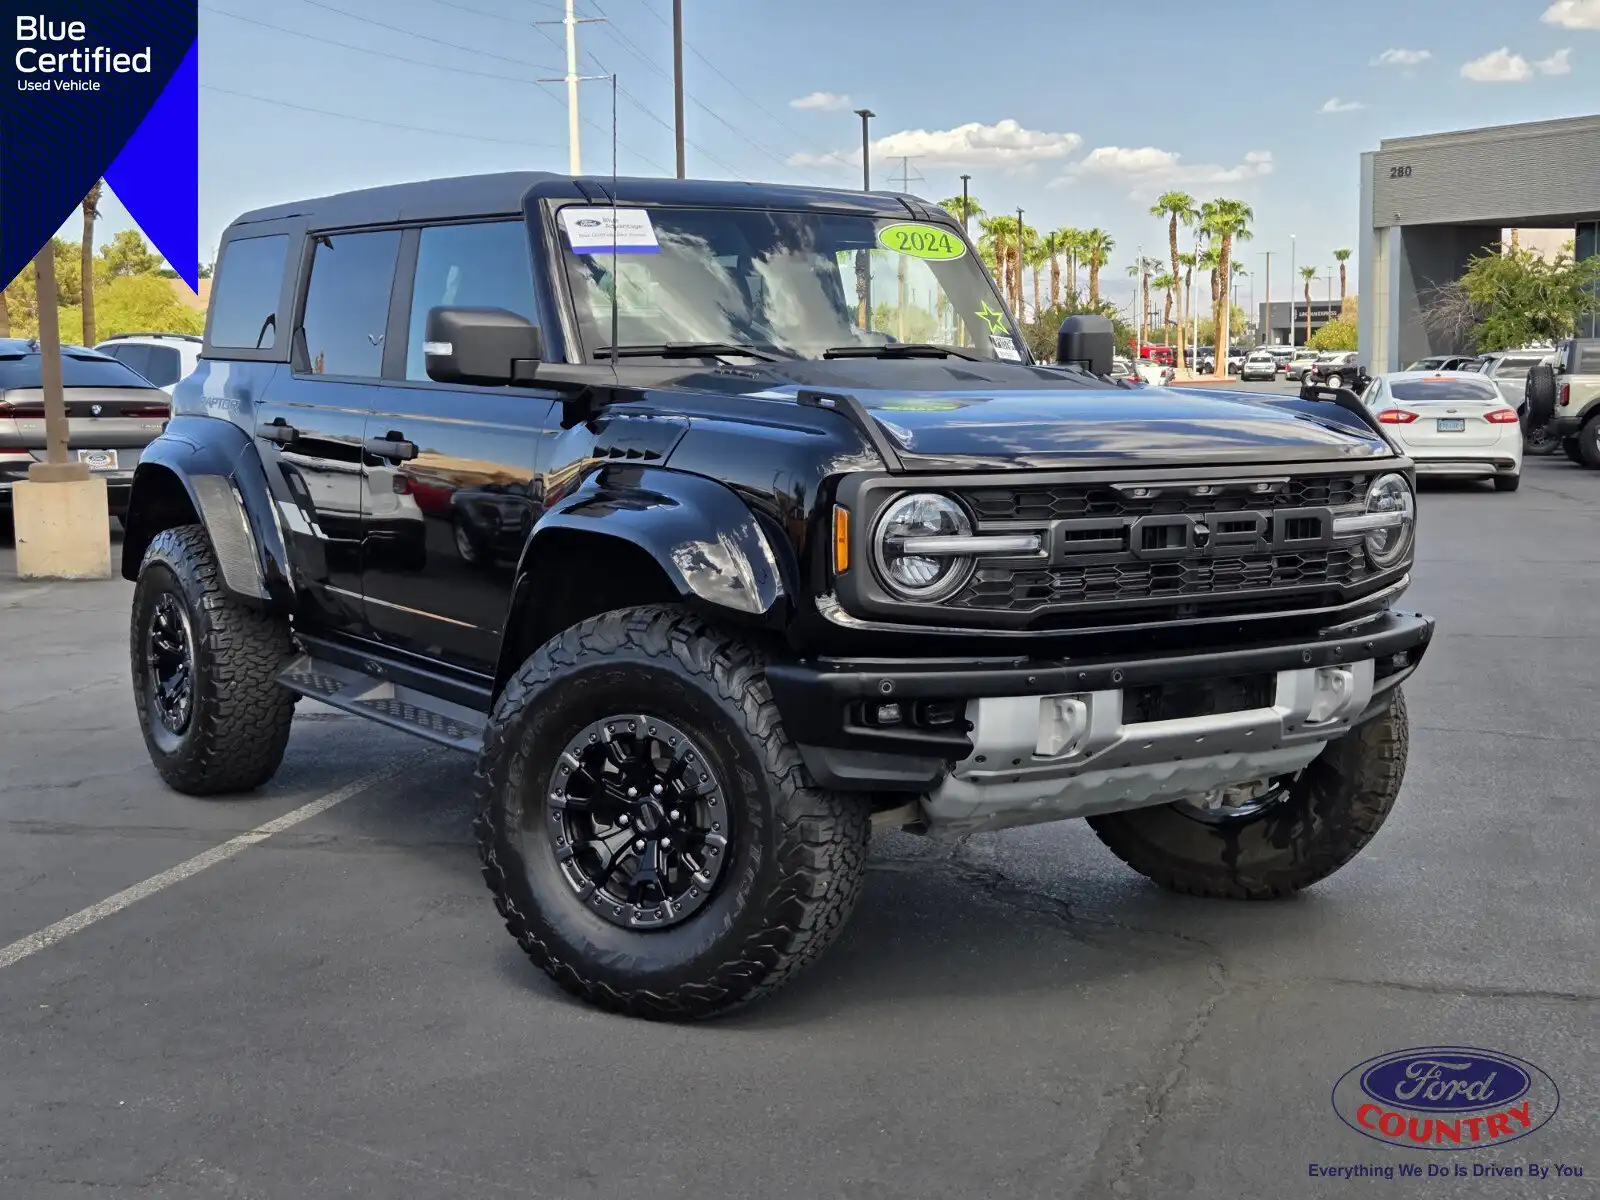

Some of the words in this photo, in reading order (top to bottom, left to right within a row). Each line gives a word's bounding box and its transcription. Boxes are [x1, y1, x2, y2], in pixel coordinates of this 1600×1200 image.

[1390, 166, 1412, 178] 280
[895, 231, 954, 253] 2024
[201, 395, 241, 411] RAPTOR
[1049, 507, 1333, 565] FORD
